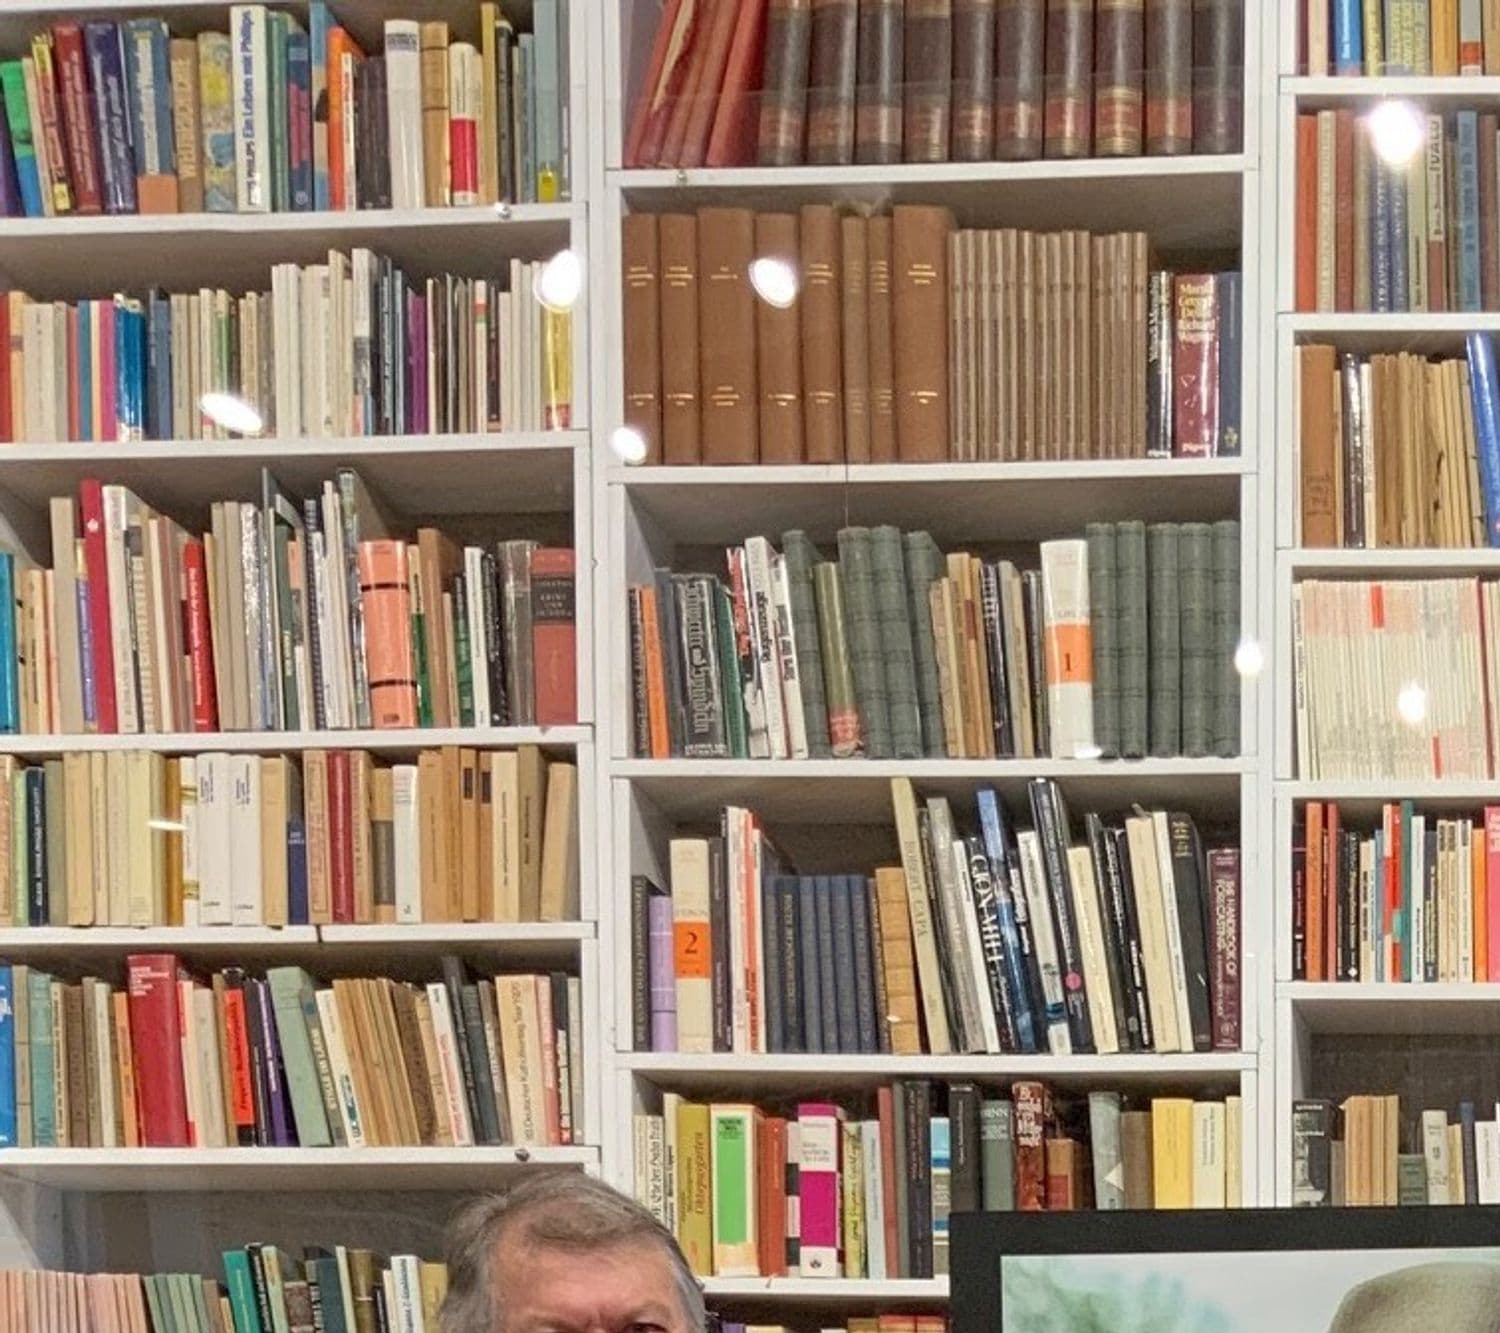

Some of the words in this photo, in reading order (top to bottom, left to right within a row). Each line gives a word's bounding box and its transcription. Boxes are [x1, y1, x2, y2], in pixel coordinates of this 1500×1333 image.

[240, 55, 253, 76] mit
[241, 78, 254, 117] Leben
[242, 119, 255, 139] Ein
[904, 840, 921, 892] ROBERT
[914, 900, 927, 938] CAPA
[1225, 879, 1237, 897] THE
[1225, 898, 1238, 959] HANDBOOK
[1226, 961, 1237, 977] OF
[317, 1059, 329, 1074] IM
[321, 1075, 337, 1110] STILLE
